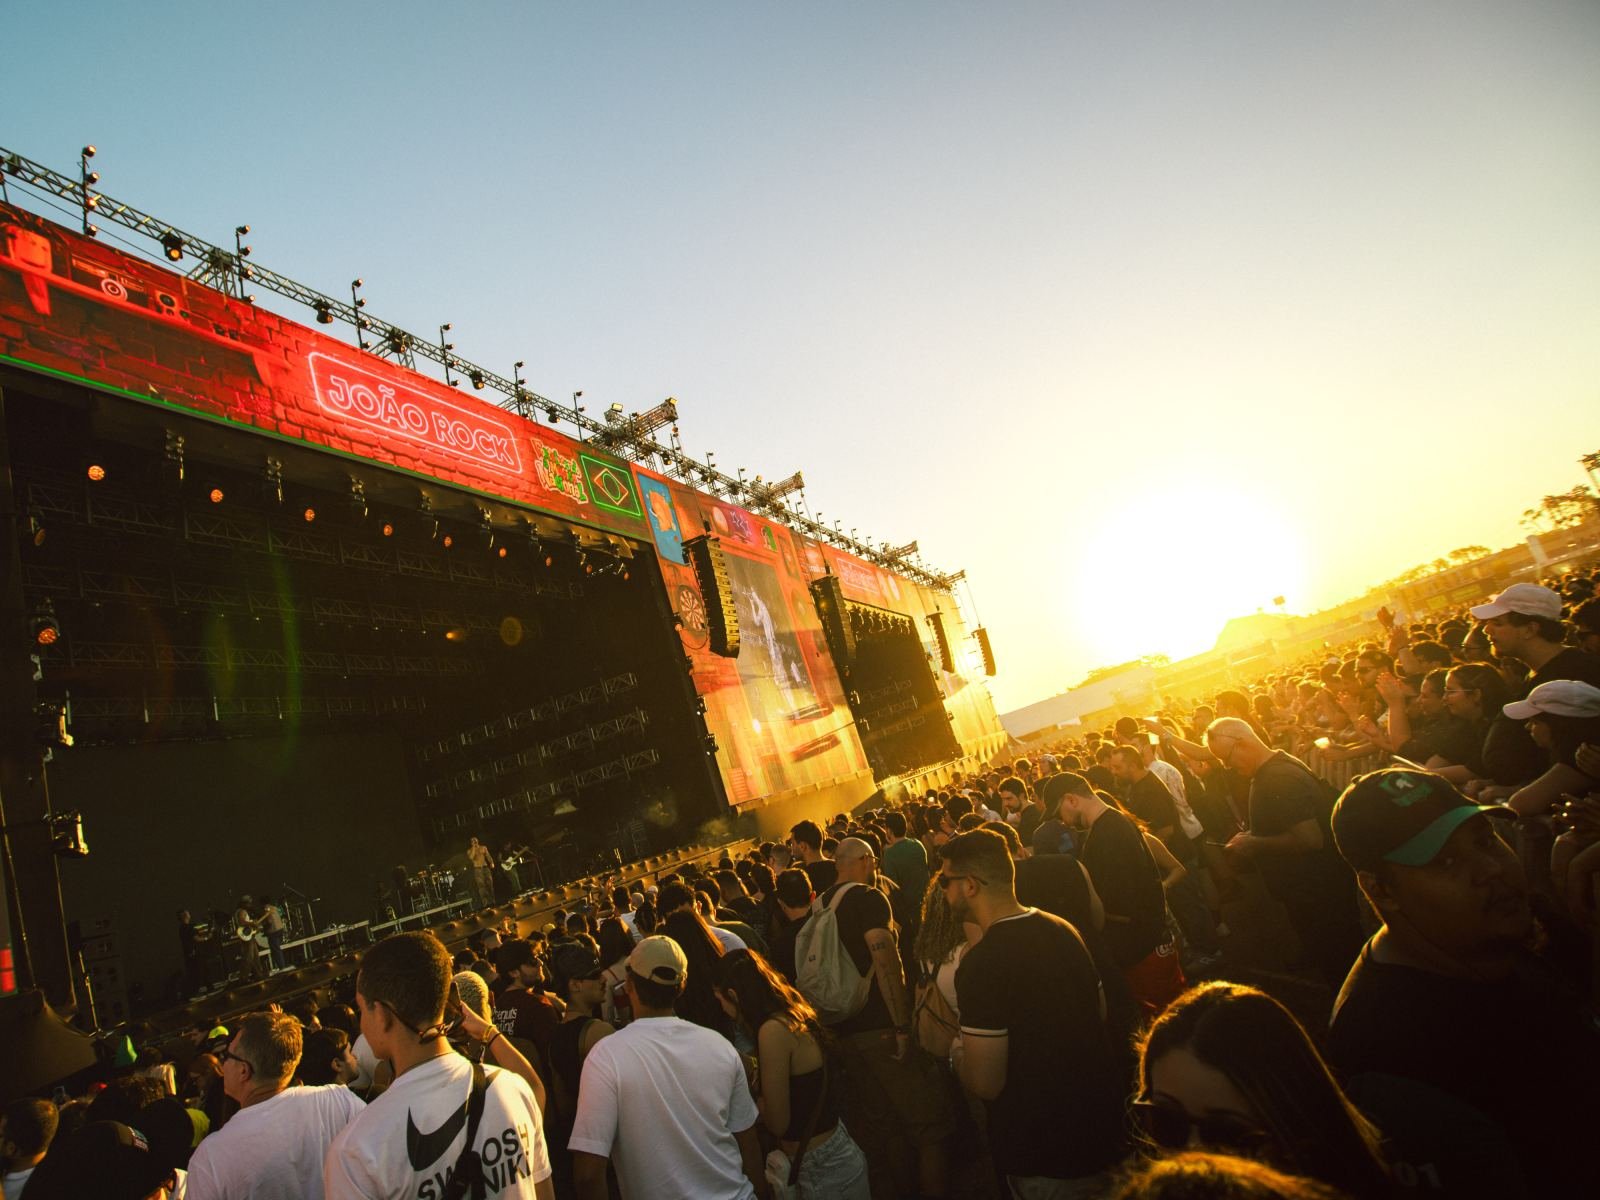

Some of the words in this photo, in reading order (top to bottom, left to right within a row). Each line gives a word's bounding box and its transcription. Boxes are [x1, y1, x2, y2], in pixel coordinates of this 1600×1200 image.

[329, 375, 429, 435] JOÃO
[431, 411, 515, 466] ROCK
[417, 1122, 530, 1200] SWOSH
